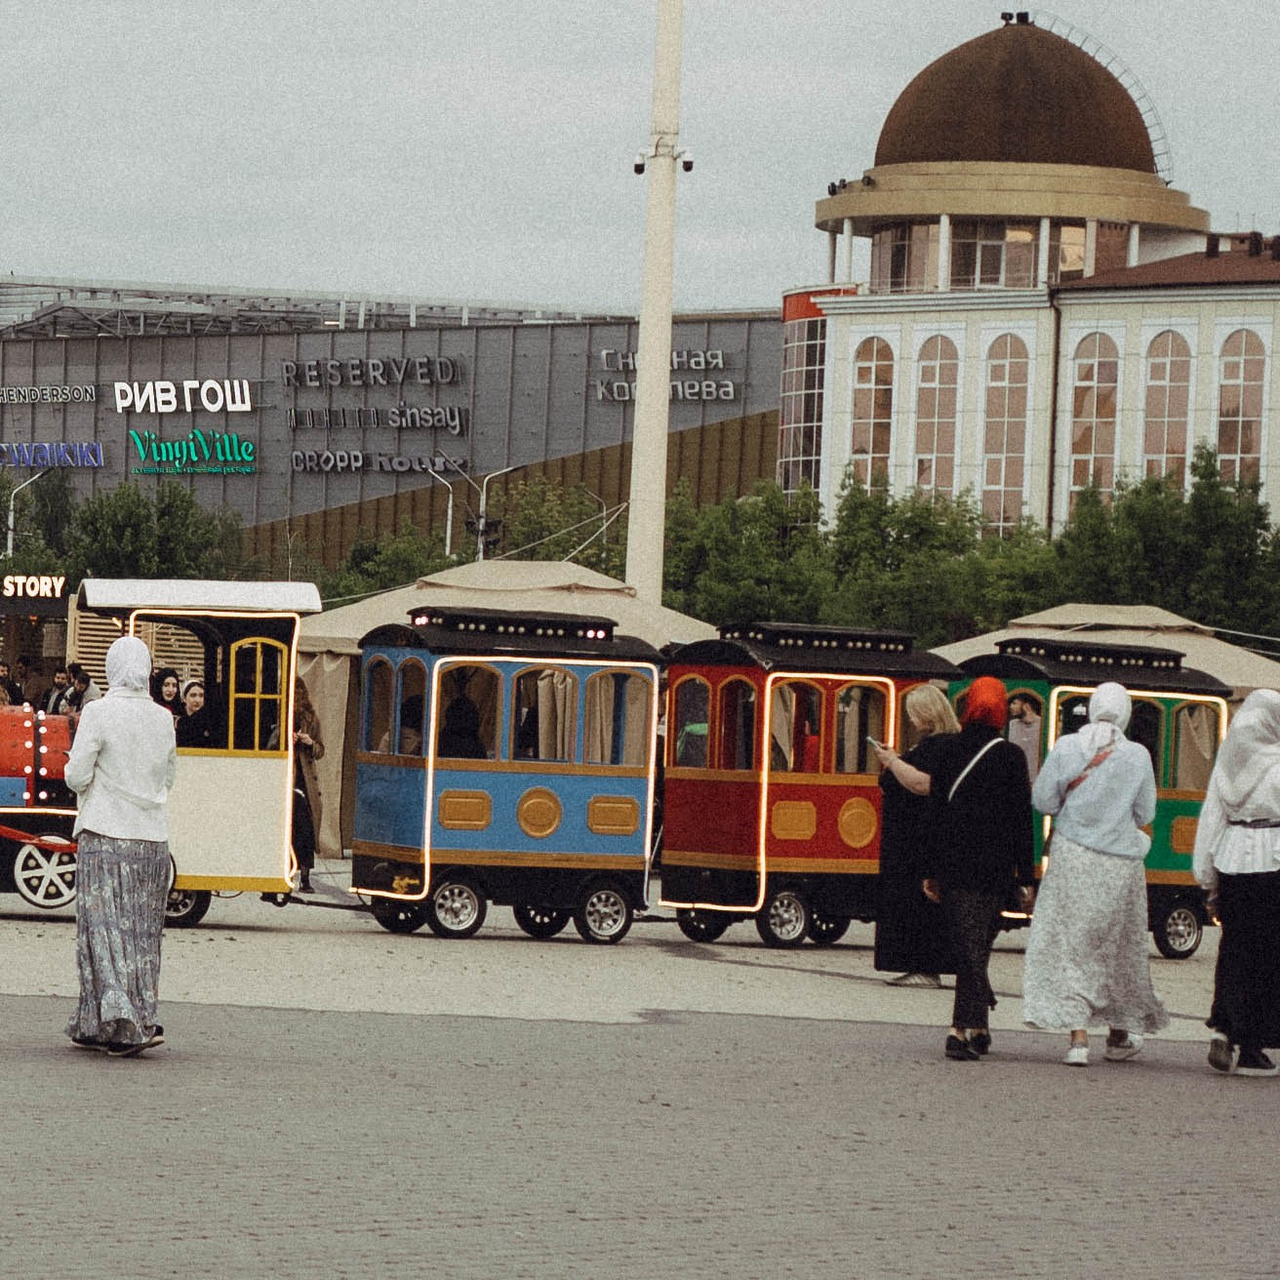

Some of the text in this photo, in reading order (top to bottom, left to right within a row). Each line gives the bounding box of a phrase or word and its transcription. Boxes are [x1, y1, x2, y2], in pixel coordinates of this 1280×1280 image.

[282, 356, 456, 387] RESERVED
[600, 348, 725, 372] Снная
[114, 378, 252, 414] РИВ ГОШ
[595, 378, 736, 402] Колева
[388, 401, 461, 436] sinsay
[292, 450, 363, 472] CROPP
[3, 575, 66, 599] STORY
